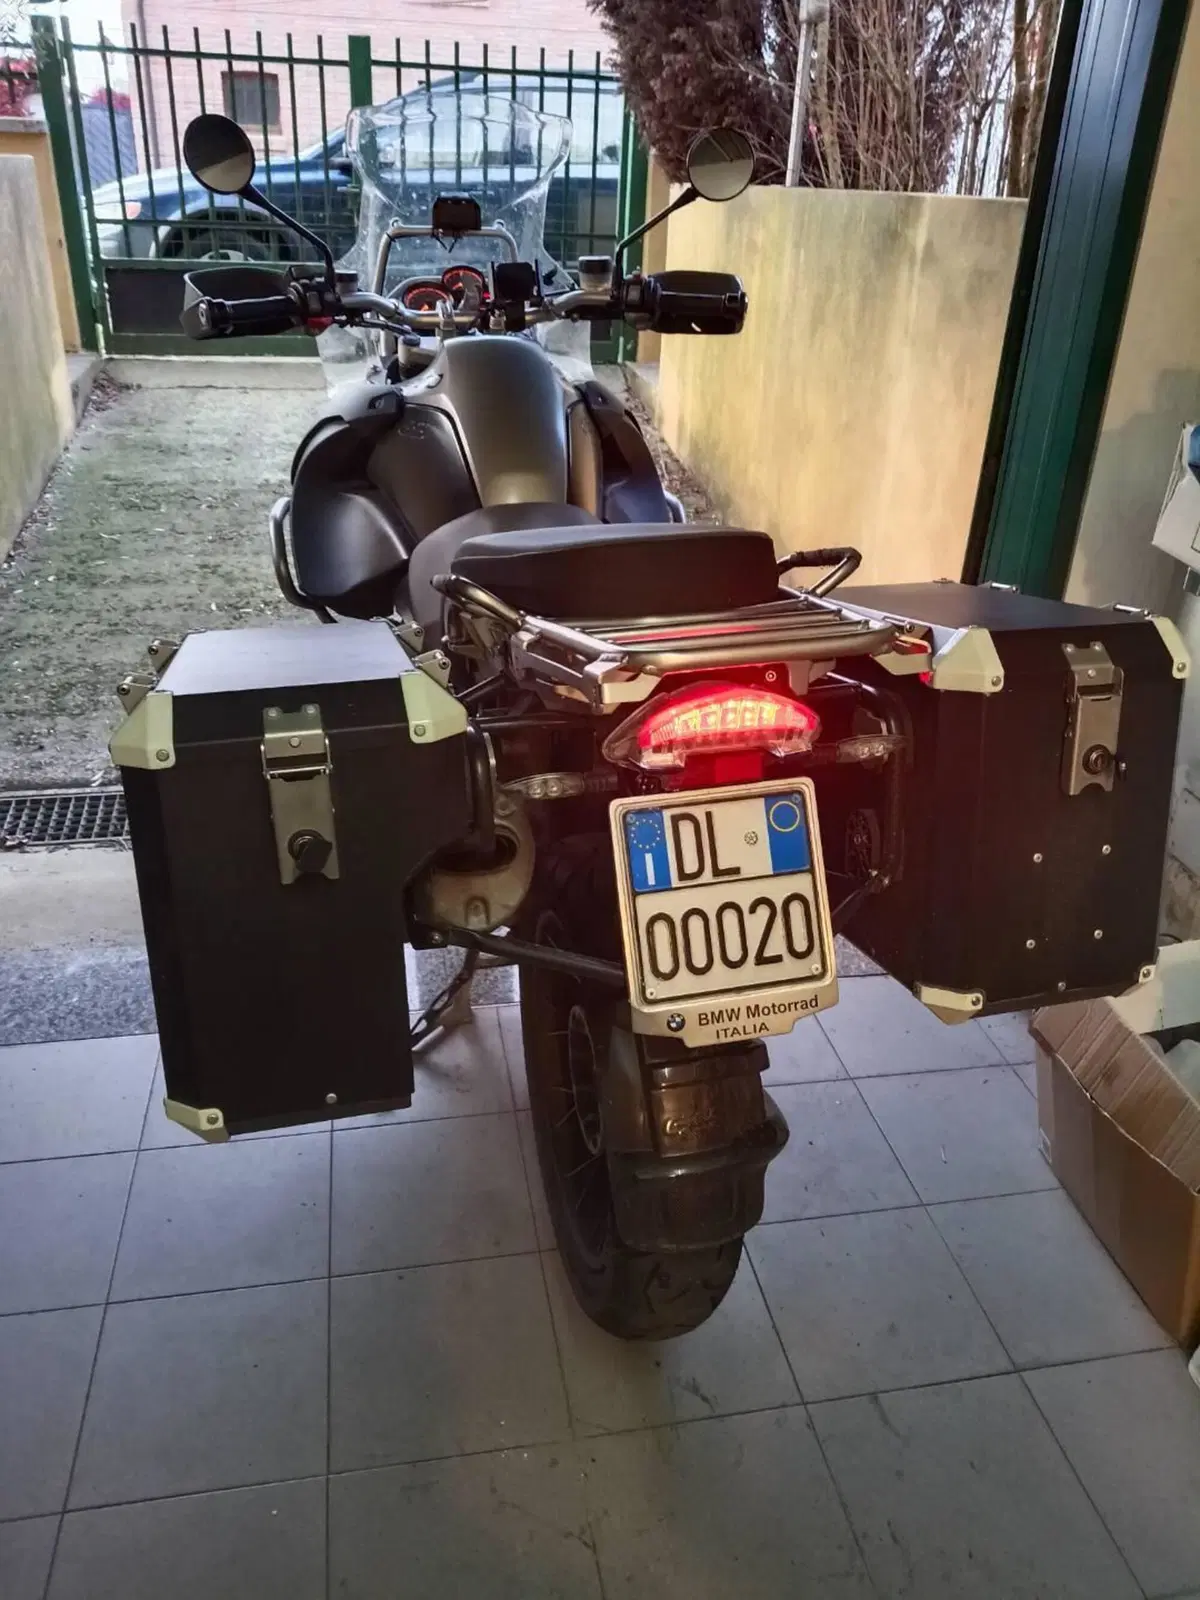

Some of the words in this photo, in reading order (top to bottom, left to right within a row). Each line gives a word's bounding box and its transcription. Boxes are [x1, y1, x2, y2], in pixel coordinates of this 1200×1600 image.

[670, 811, 741, 882] DL
[644, 853, 655, 885] I
[645, 892, 815, 981] 00020
[698, 1006, 741, 1026] BMW
[746, 994, 819, 1019] Motorrad
[716, 1022, 770, 1039] ITALIA
